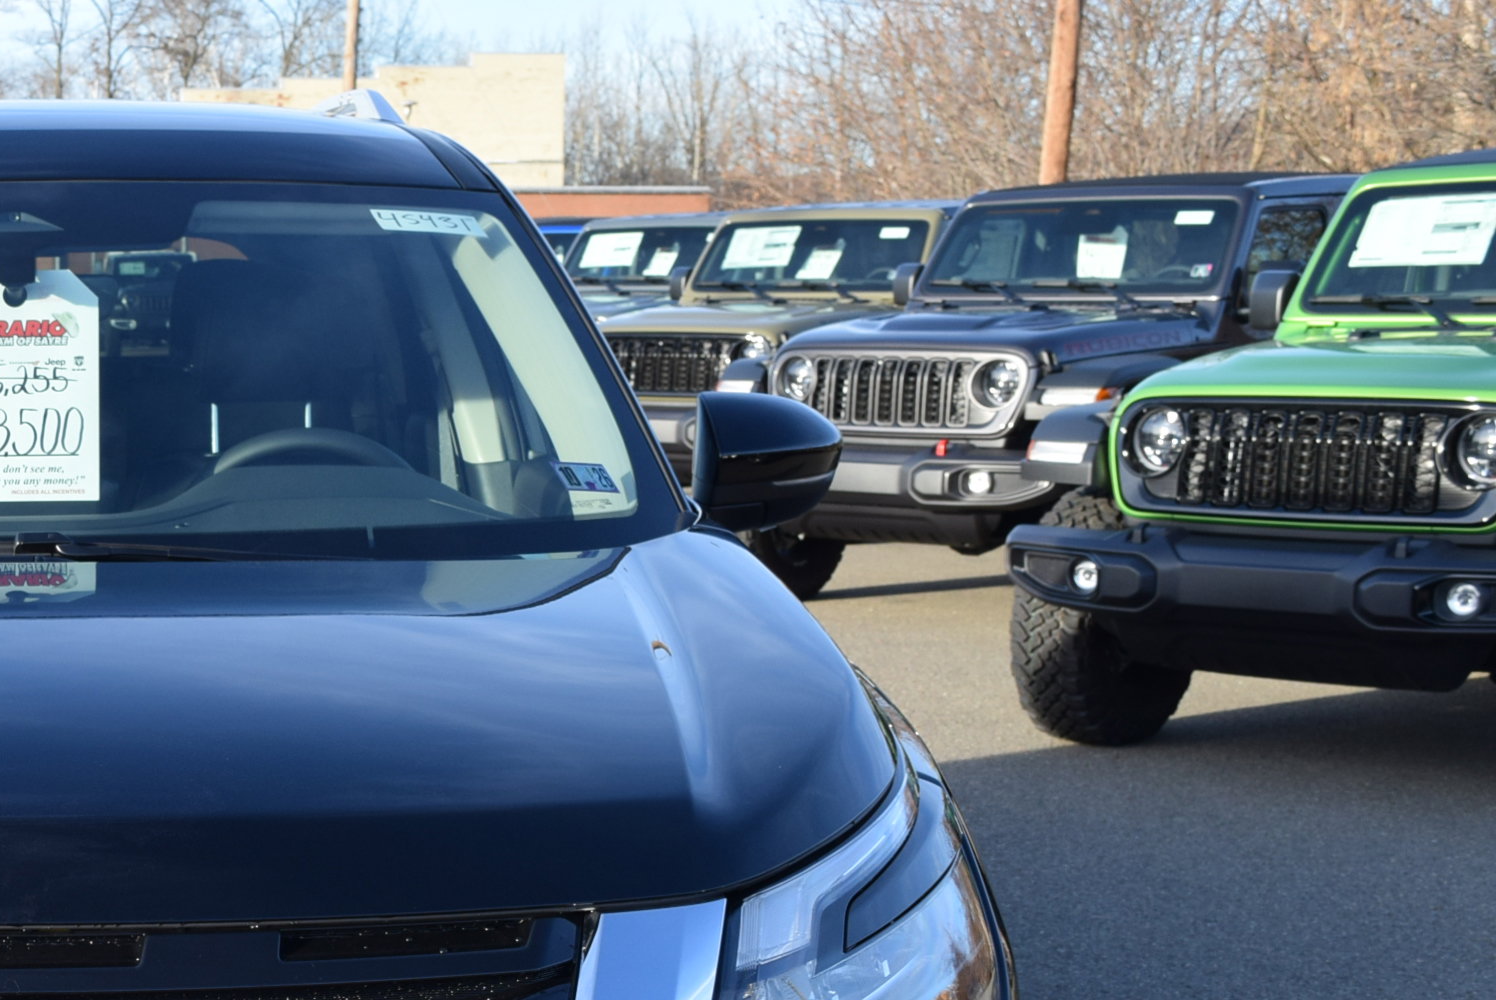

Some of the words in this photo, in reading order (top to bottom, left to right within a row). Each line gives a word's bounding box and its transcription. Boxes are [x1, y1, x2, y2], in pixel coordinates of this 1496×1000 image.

[16, 336, 32, 347] OF
[33, 336, 68, 347] SAYRE
[44, 358, 66, 367] Jeep
[3, 464, 28, 474] don't
[30, 466, 45, 474] see
[47, 465, 65, 474] me,
[591, 467, 615, 488] 26
[2, 478, 21, 487] you
[23, 478, 41, 488] any
